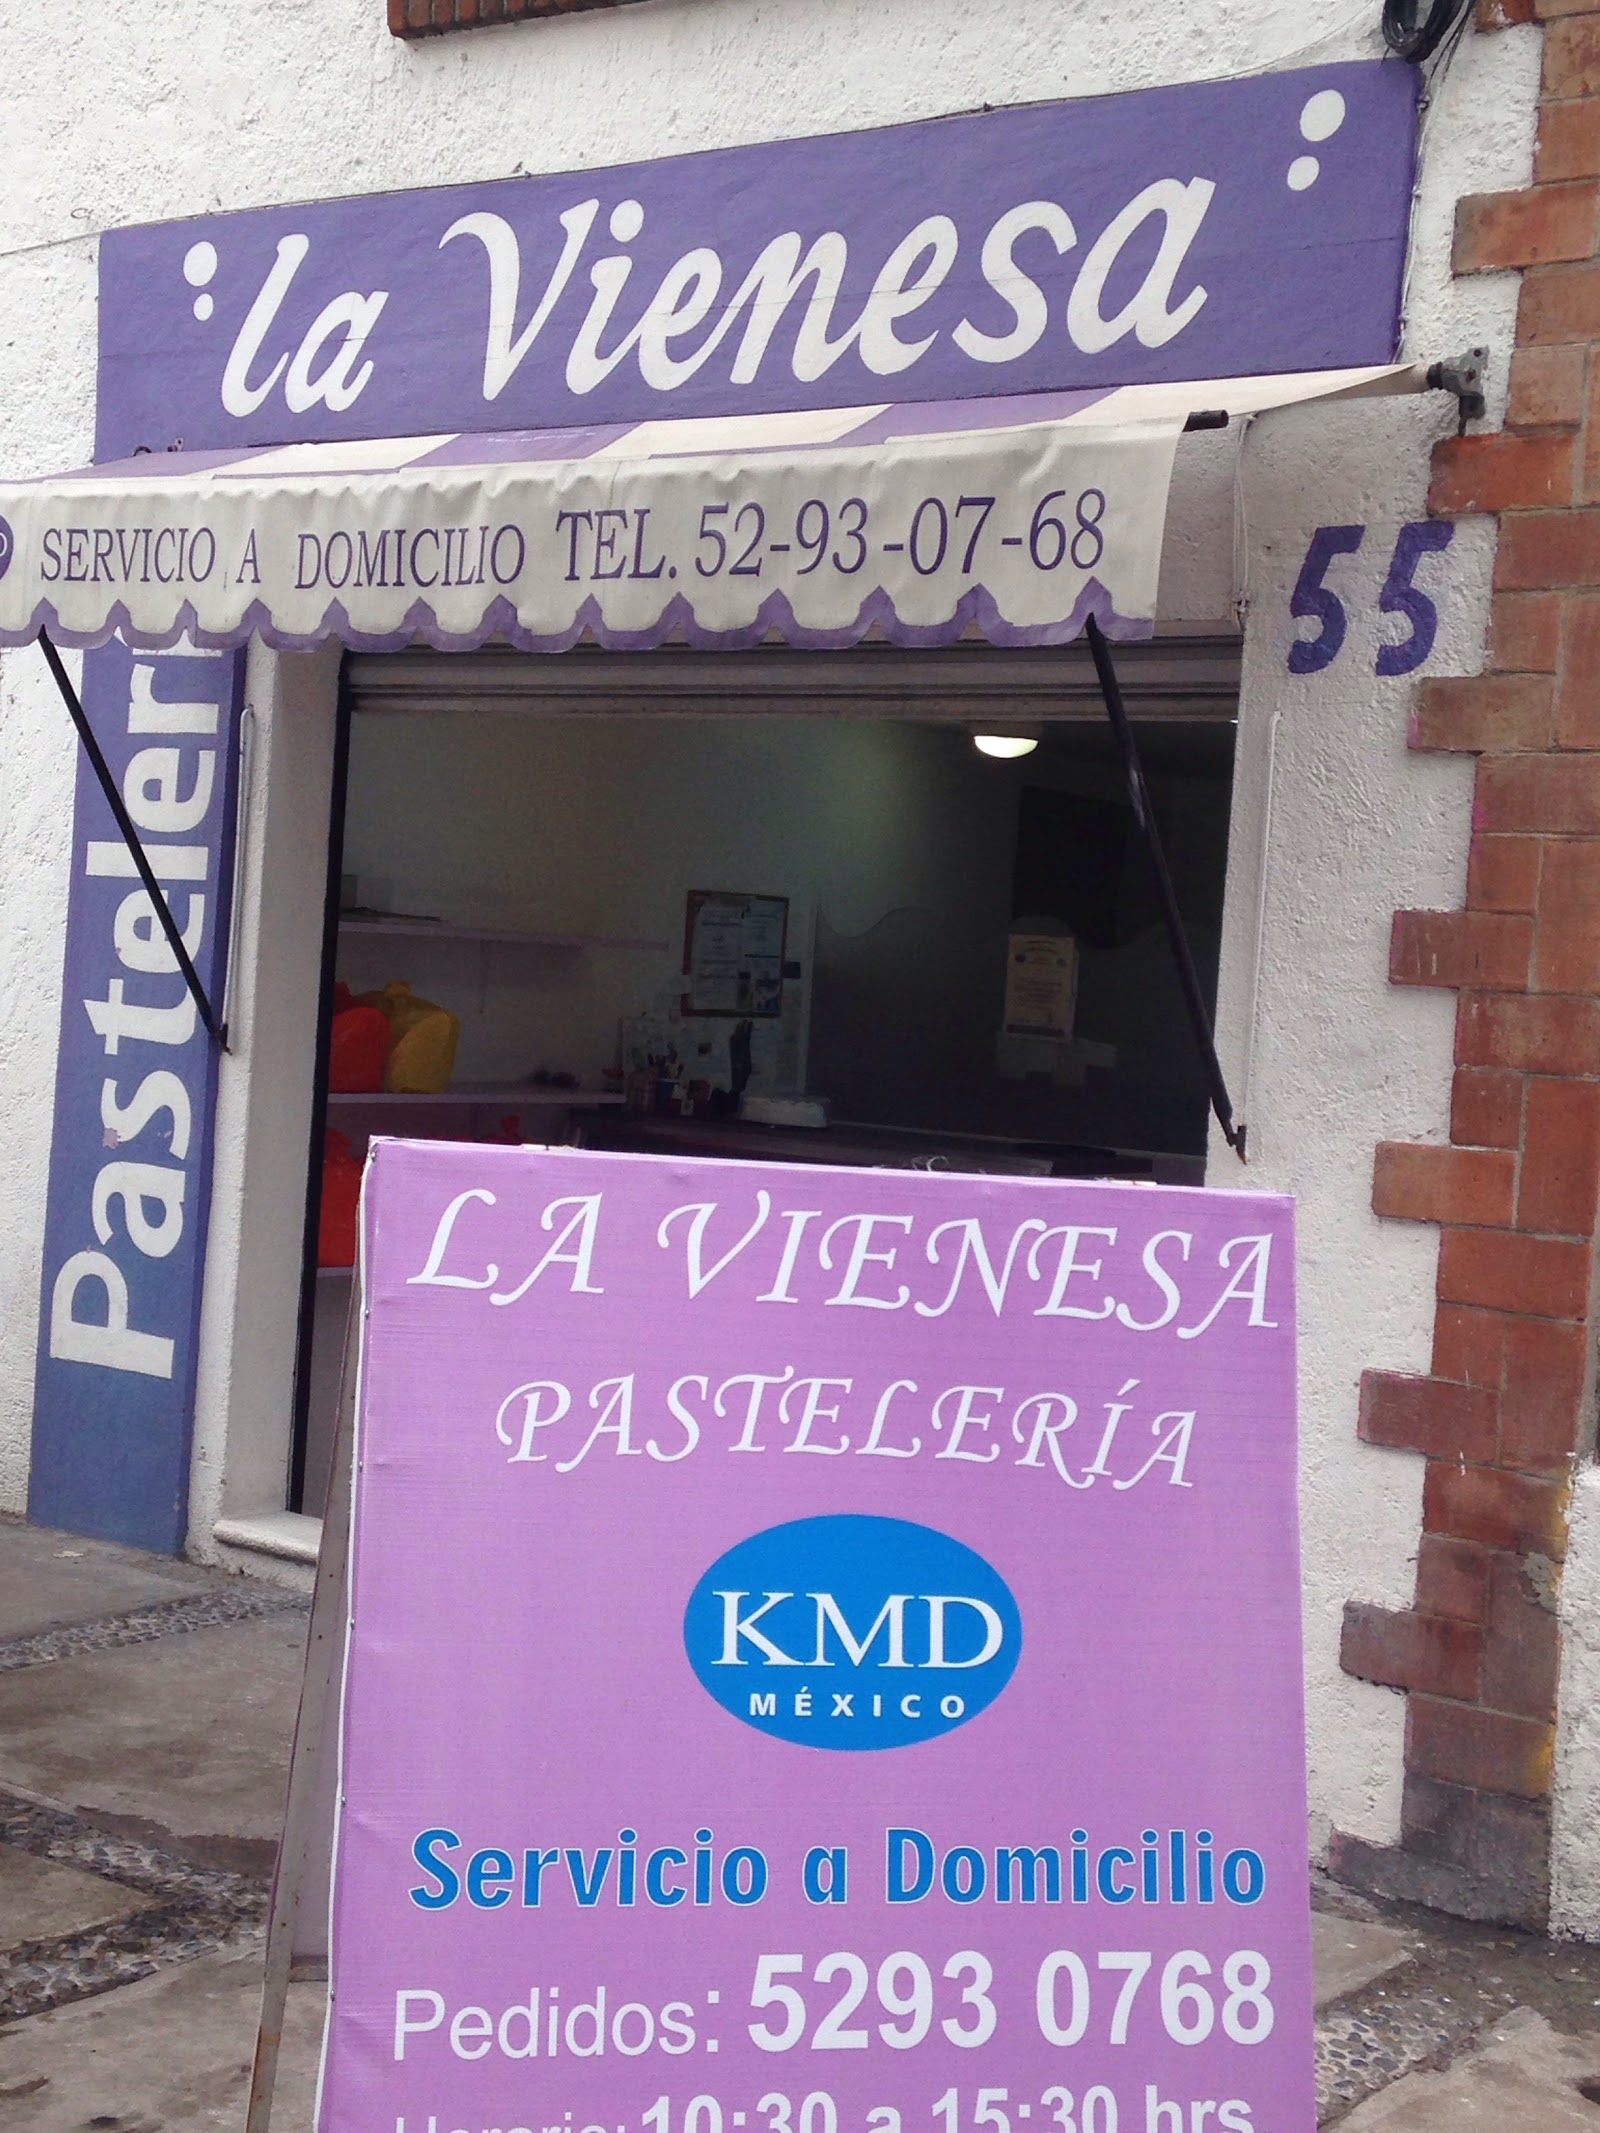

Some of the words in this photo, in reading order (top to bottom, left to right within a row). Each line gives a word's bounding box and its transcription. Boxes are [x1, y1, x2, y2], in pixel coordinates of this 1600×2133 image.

[222, 233, 389, 418] la
[439, 176, 1215, 402] Vienesa
[40, 526, 217, 584] SERVICIO
[236, 528, 262, 585] A
[295, 525, 525, 589] DOMICILIO
[556, 507, 678, 581] TEL.
[1287, 519, 1453, 678] 55
[405, 1188, 604, 1306] LA
[657, 1189, 1278, 1340] VIENESA
[495, 1365, 1197, 1491] PASTELERÍA
[710, 1591, 1004, 1669] KMD
[749, 1686, 966, 1719] MÉXICO
[409, 1827, 769, 1910] Servicio
[803, 1844, 847, 1905] a
[885, 1826, 1266, 1905] Domicilio
[394, 1986, 721, 2061] Pedidos:
[747, 1950, 998, 2053] 5293
[1036, 1950, 1275, 2048] 0768
